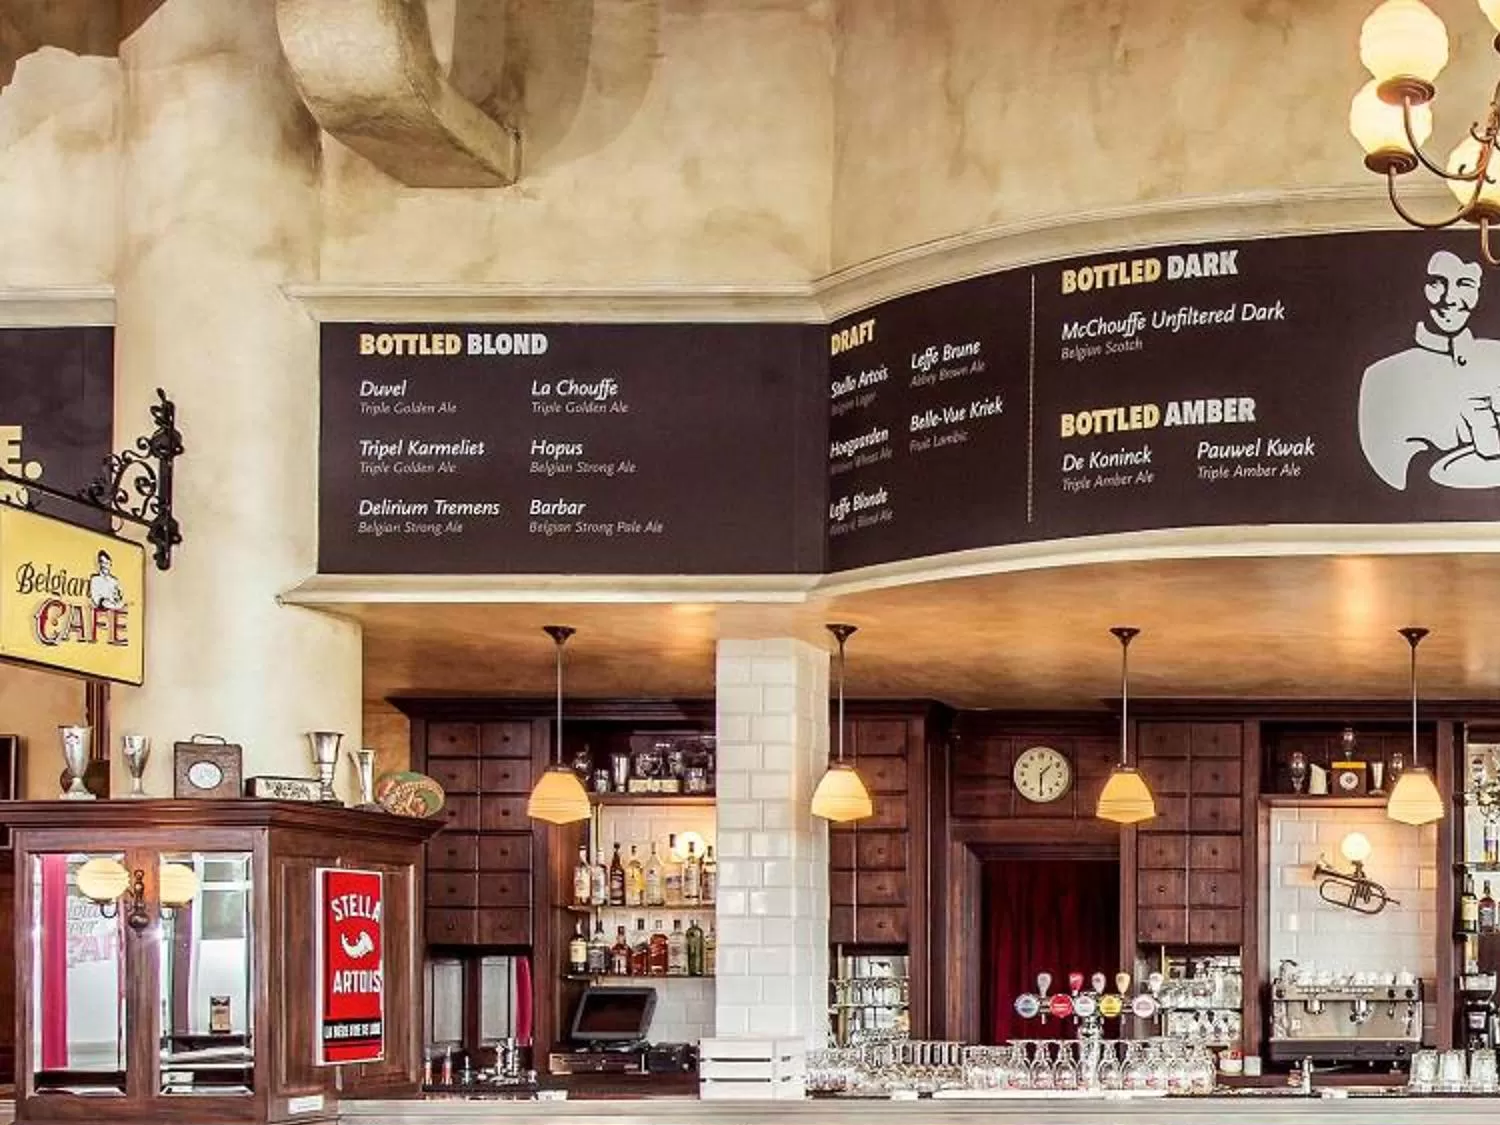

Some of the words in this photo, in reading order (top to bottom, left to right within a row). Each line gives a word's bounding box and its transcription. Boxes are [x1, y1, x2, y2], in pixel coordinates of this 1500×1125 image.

[1062, 258, 1160, 295] BOTTLED
[1167, 250, 1238, 280] DARK
[1062, 312, 1146, 340] McChouffe
[1152, 304, 1235, 333] Unfiltered
[1241, 301, 1285, 322] Dark
[359, 334, 461, 355] BOTTLED
[467, 334, 548, 355] BLOND
[831, 319, 875, 355] DRAFT
[1105, 338, 1143, 356] Scotch
[911, 345, 939, 372] Leffe
[943, 341, 981, 361] Brune
[360, 380, 406, 397] Duvel
[532, 380, 551, 396] La
[556, 379, 618, 400] Chouffe
[360, 402, 392, 416] Triple
[395, 402, 436, 414] Golden
[438, 402, 456, 414] Ale
[531, 402, 563, 416] Triple
[566, 402, 607, 414] Golden
[610, 402, 628, 414] Ale
[970, 395, 1002, 419] Kriek
[1061, 405, 1159, 438] BOTTLED
[1164, 398, 1256, 427] AMBER
[360, 440, 402, 459] Tripel
[408, 440, 485, 456] Karmeliet
[531, 440, 583, 459] Hopus
[1063, 453, 1084, 471] De
[1090, 446, 1152, 468] Koninck
[1197, 440, 1260, 460] Pauwel
[1267, 437, 1315, 457] Kwak
[360, 462, 391, 476] Triple
[394, 462, 435, 474] Golden
[438, 462, 456, 474] Ale
[530, 462, 573, 476] Belgian
[577, 462, 614, 476] Strong
[617, 462, 636, 474] Ale
[1198, 465, 1230, 481] Triple
[1234, 464, 1276, 479] Amber
[1280, 463, 1300, 477] Ale
[1062, 476, 1093, 492] Triple
[1136, 470, 1155, 485] Ale
[359, 499, 428, 516] Delirium
[435, 500, 500, 516] Tremens
[530, 500, 585, 516] Barbar
[359, 520, 400, 535] Belgian
[404, 521, 442, 535] Strong
[445, 521, 463, 533] Ale
[529, 521, 572, 535] Belgian
[575, 521, 613, 535] Strong
[616, 521, 642, 533] Pale
[645, 521, 663, 533] Ale
[16, 561, 91, 598] Belgian
[331, 894, 382, 922] STELLA
[333, 969, 383, 993] ARTOIS
